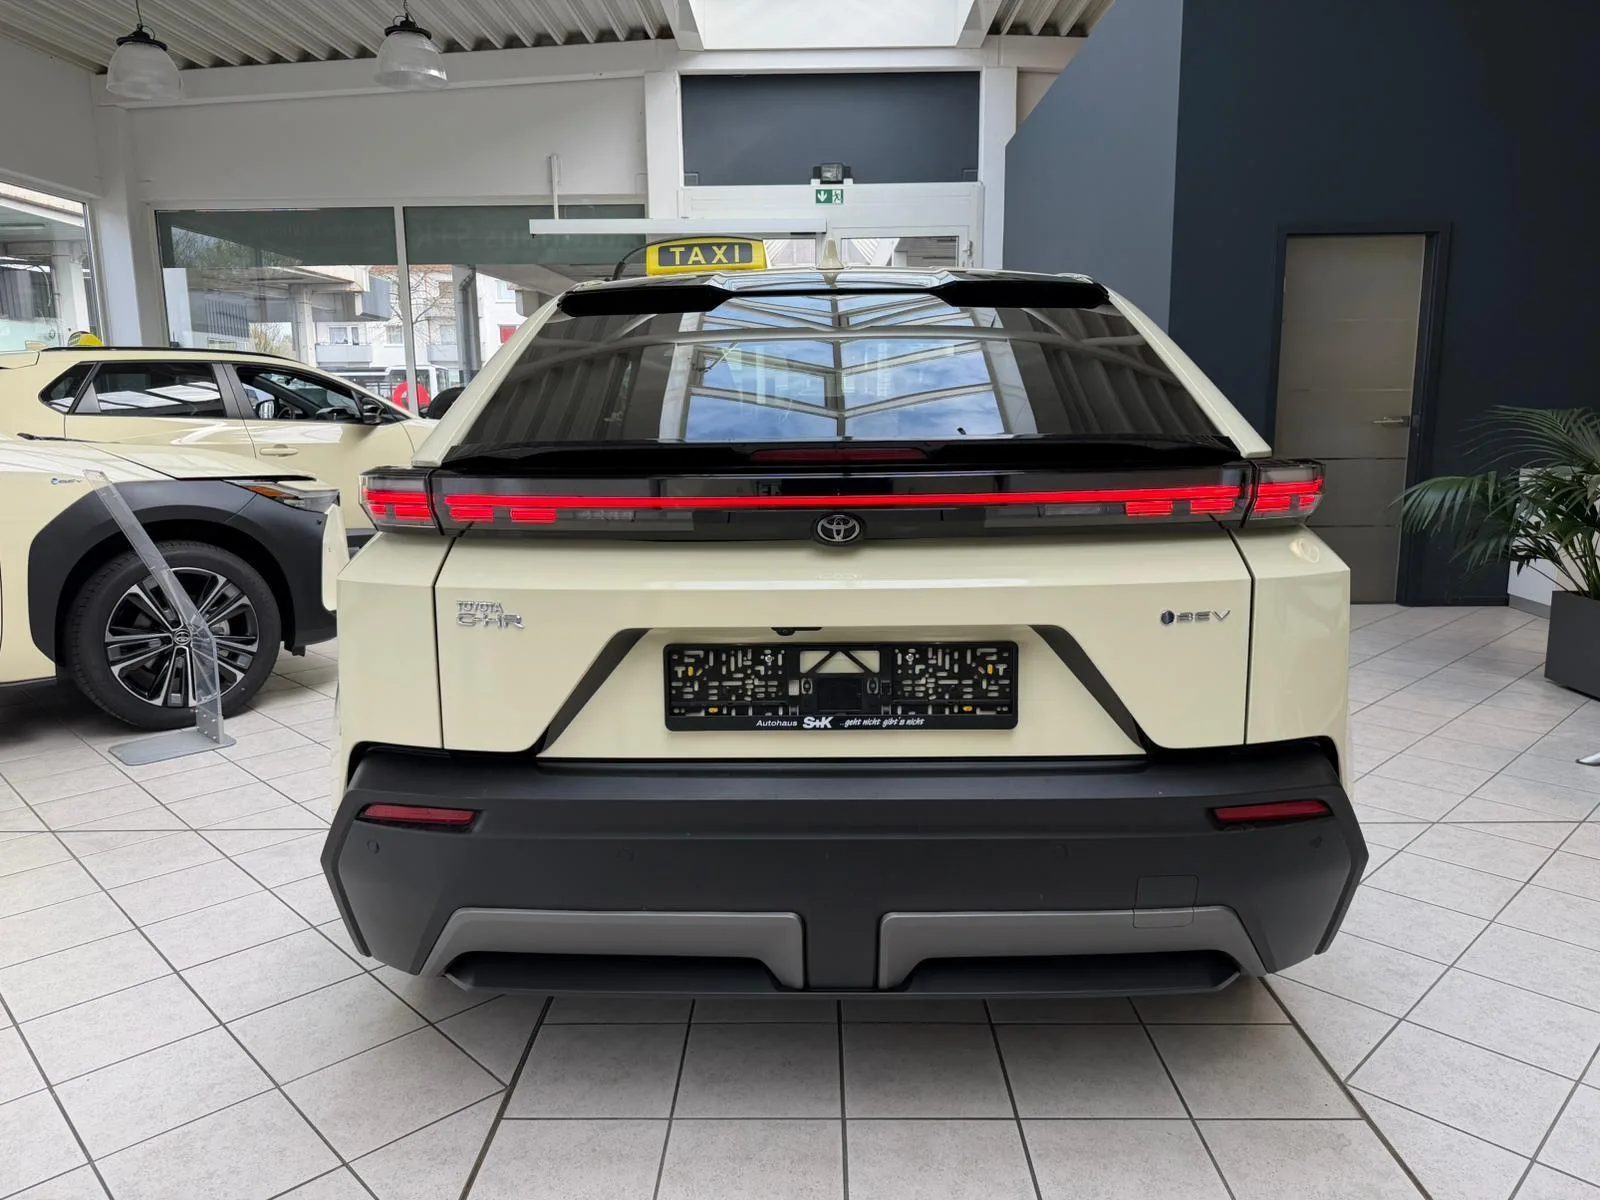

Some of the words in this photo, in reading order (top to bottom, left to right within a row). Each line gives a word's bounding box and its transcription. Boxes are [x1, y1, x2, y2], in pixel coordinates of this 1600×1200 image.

[669, 245, 740, 265] TAXI
[456, 600, 504, 613] TOYOTA
[456, 612, 525, 629] C-HR
[1177, 610, 1231, 623] BEV
[756, 719, 798, 727] Autohaus
[803, 716, 834, 729] S+K
